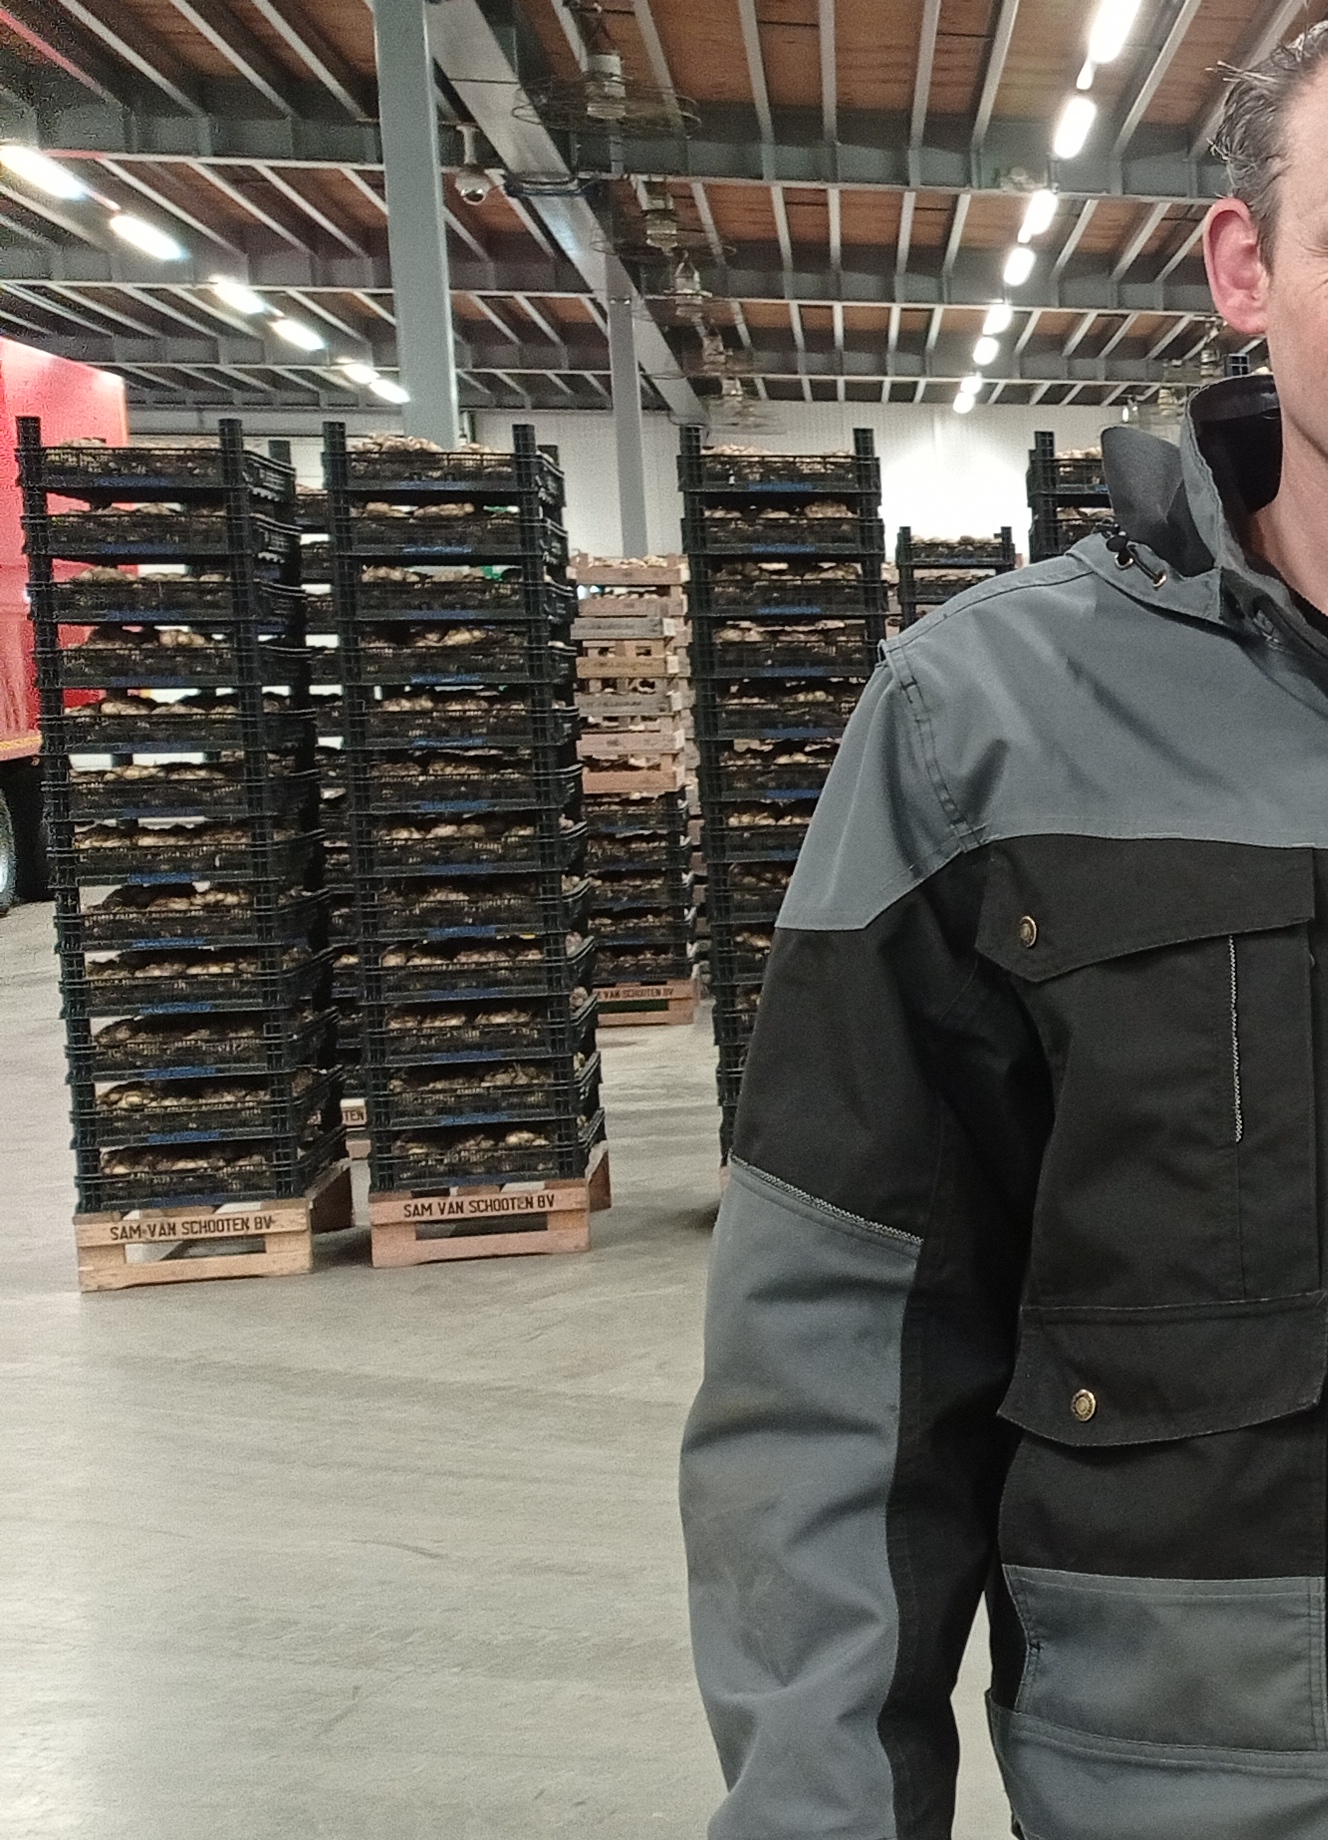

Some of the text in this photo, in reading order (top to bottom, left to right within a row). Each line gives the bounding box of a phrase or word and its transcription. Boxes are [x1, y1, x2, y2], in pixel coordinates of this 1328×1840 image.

[403, 1194, 555, 1218] SAM VAN SCHOOTEN BV
[110, 1215, 272, 1240] SAM VAN SCHOOTEN BV
